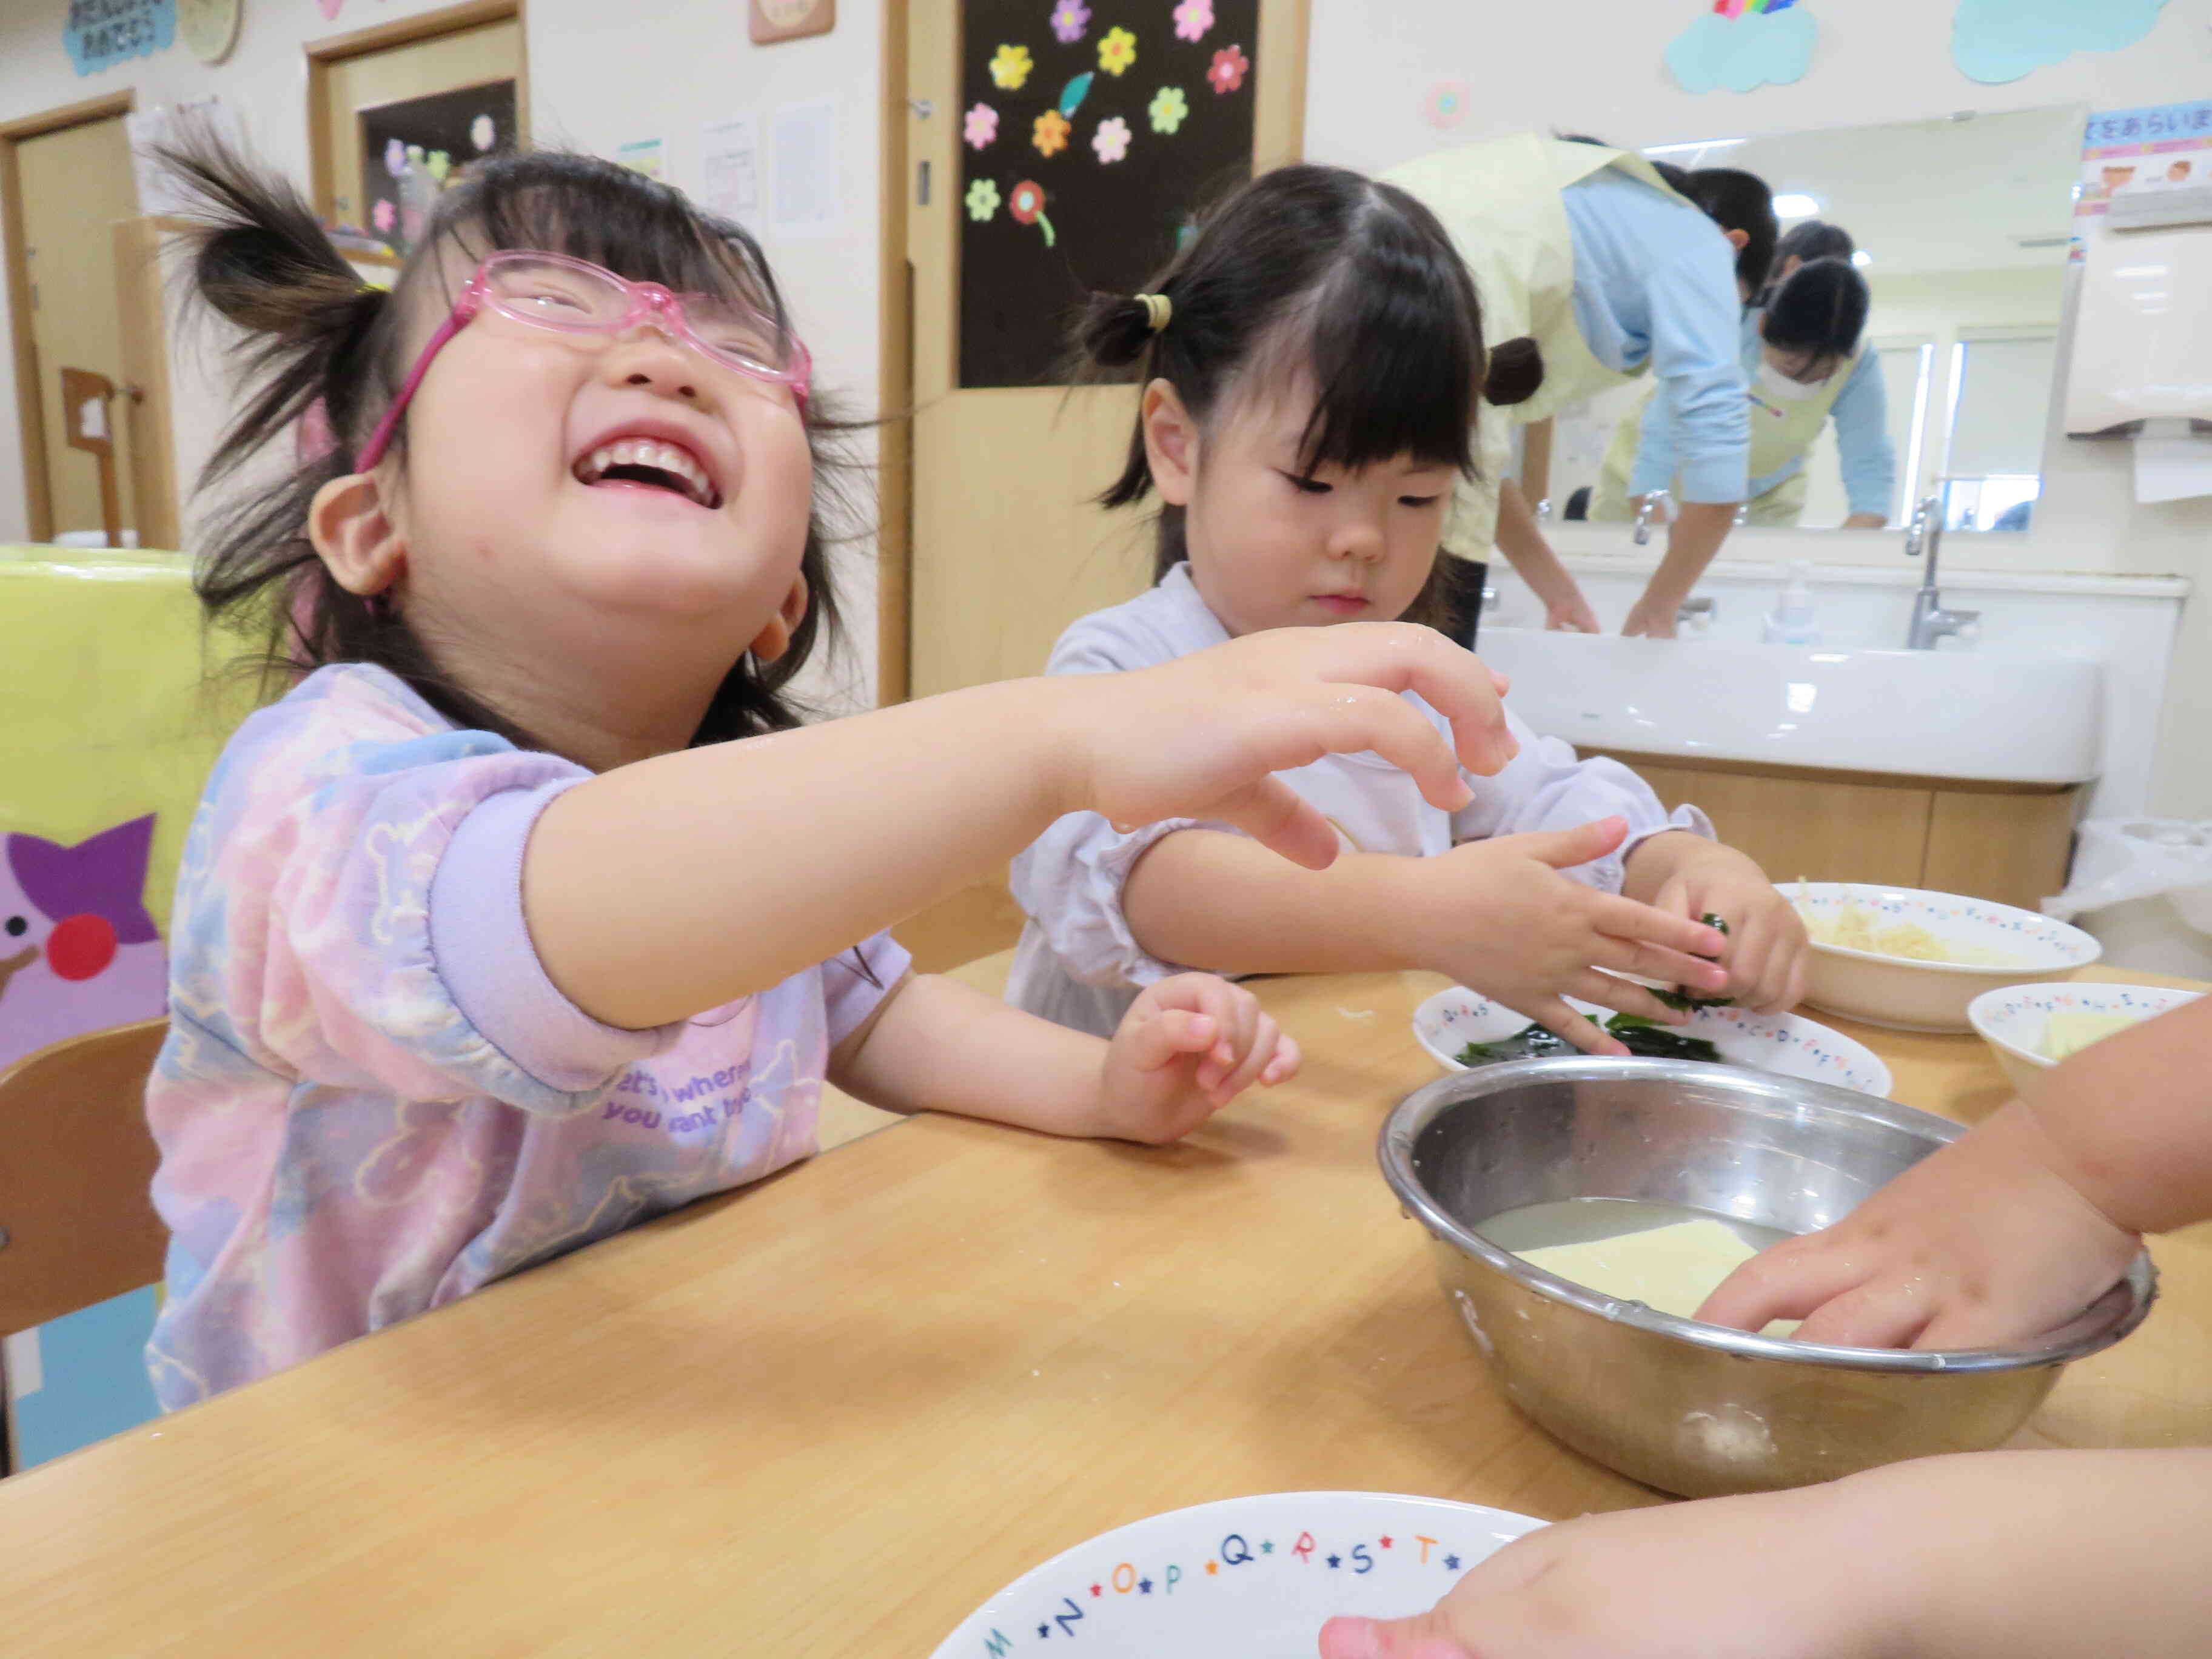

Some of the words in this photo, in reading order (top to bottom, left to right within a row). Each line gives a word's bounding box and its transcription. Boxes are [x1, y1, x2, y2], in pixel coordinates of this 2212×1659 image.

[602, 1101, 662, 1129] you
[1054, 1597, 1084, 1637] N
[1111, 1562, 1137, 1594] O
[1165, 1564, 1182, 1595] P
[1221, 1534, 1255, 1566] Q
[1291, 1531, 1316, 1564] R
[1351, 1544, 1373, 1574] S
[1414, 1535, 1439, 1564] T
